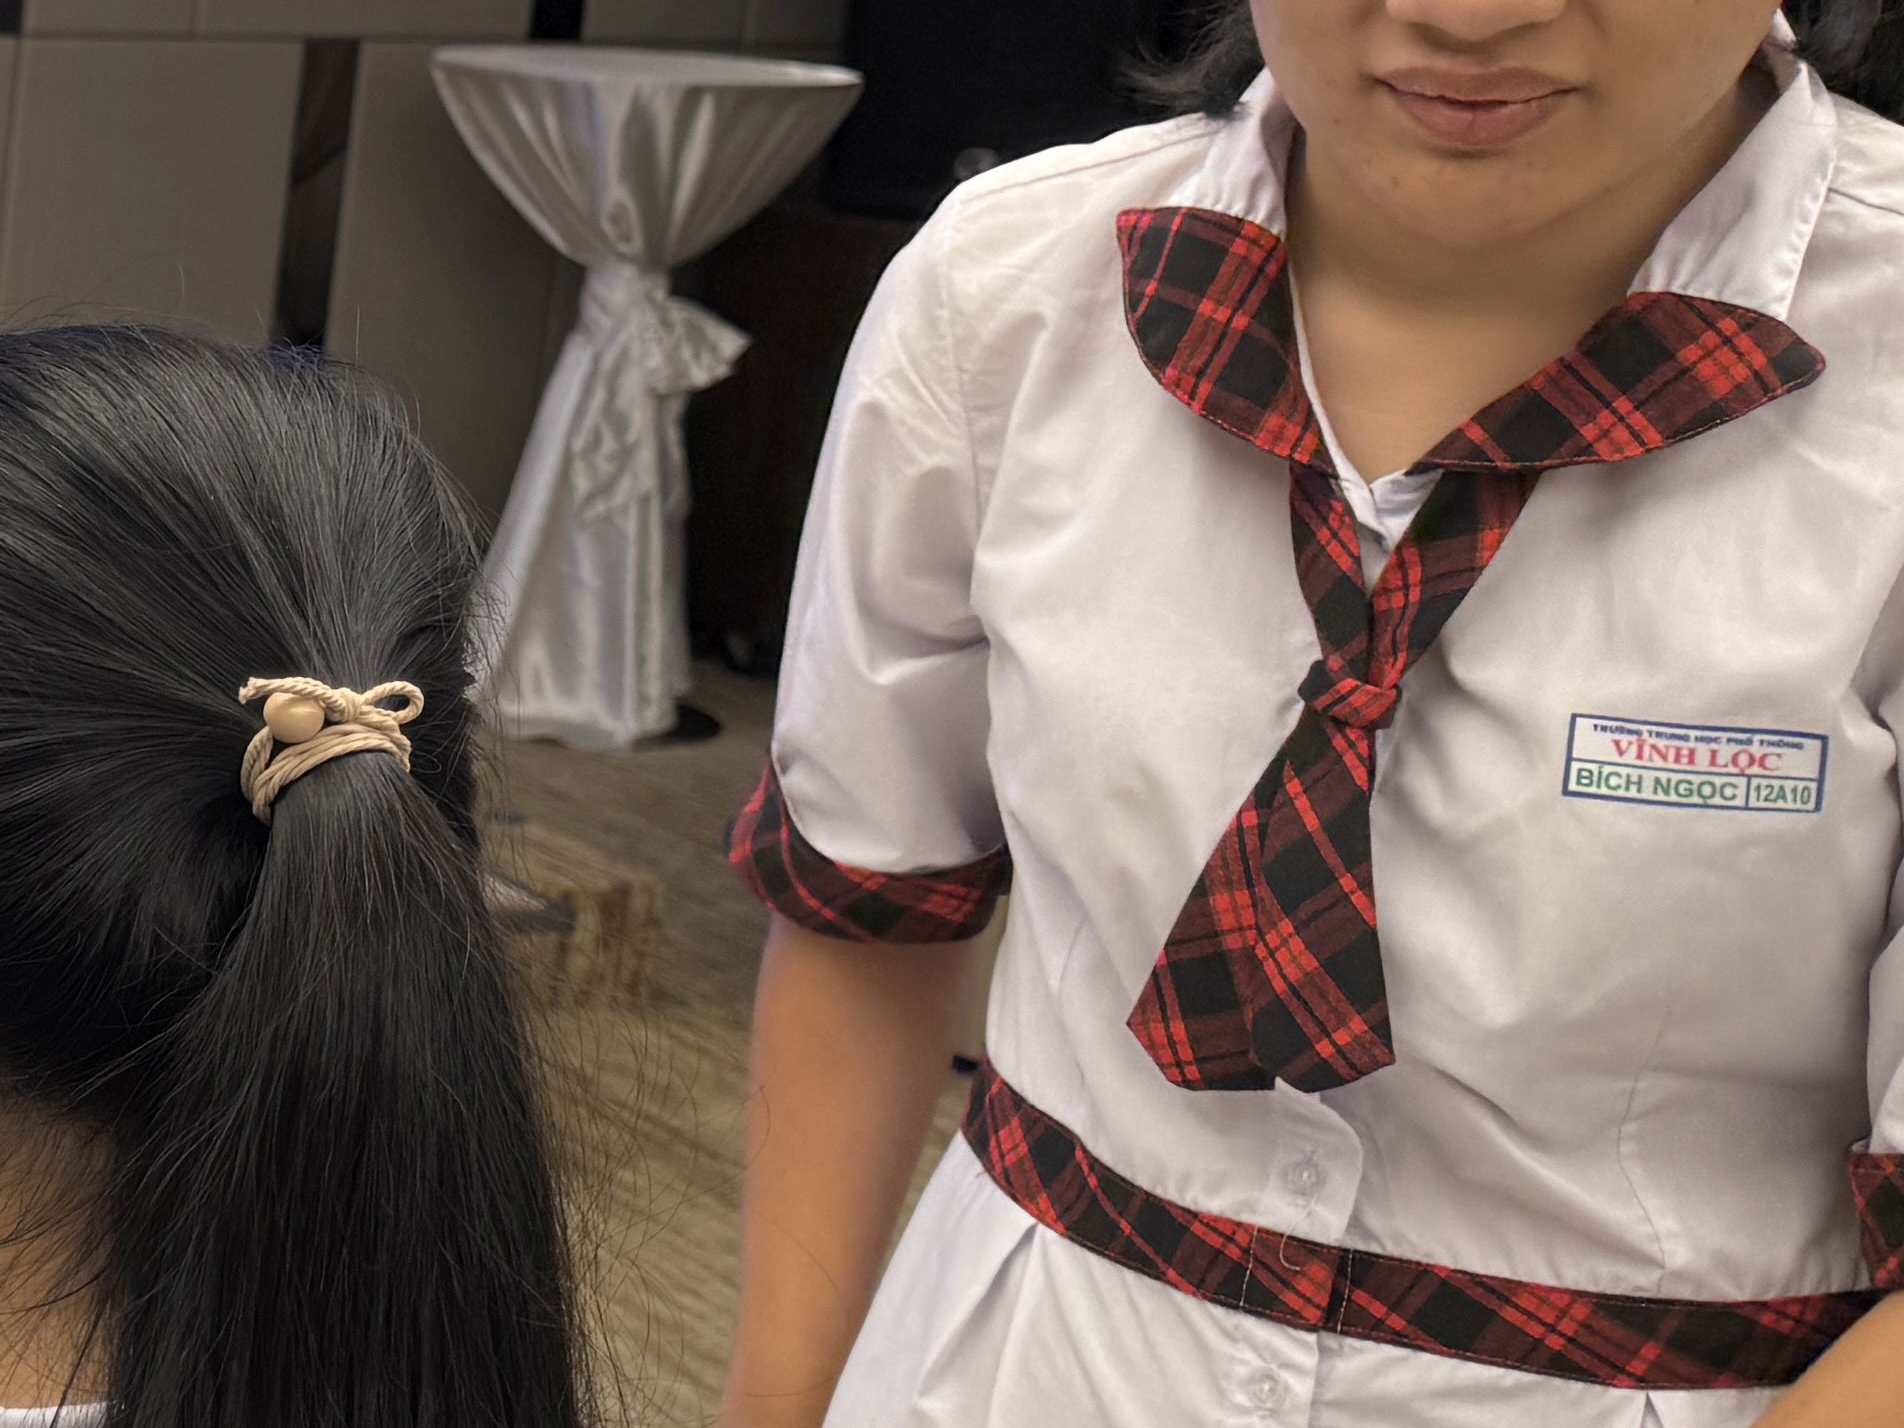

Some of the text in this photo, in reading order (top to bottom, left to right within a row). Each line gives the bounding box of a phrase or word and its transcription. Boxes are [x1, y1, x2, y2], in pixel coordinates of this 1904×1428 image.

[1610, 737, 1696, 767] VĨNH
[1575, 764, 1812, 806] BÍCH NGỌC 12A10
